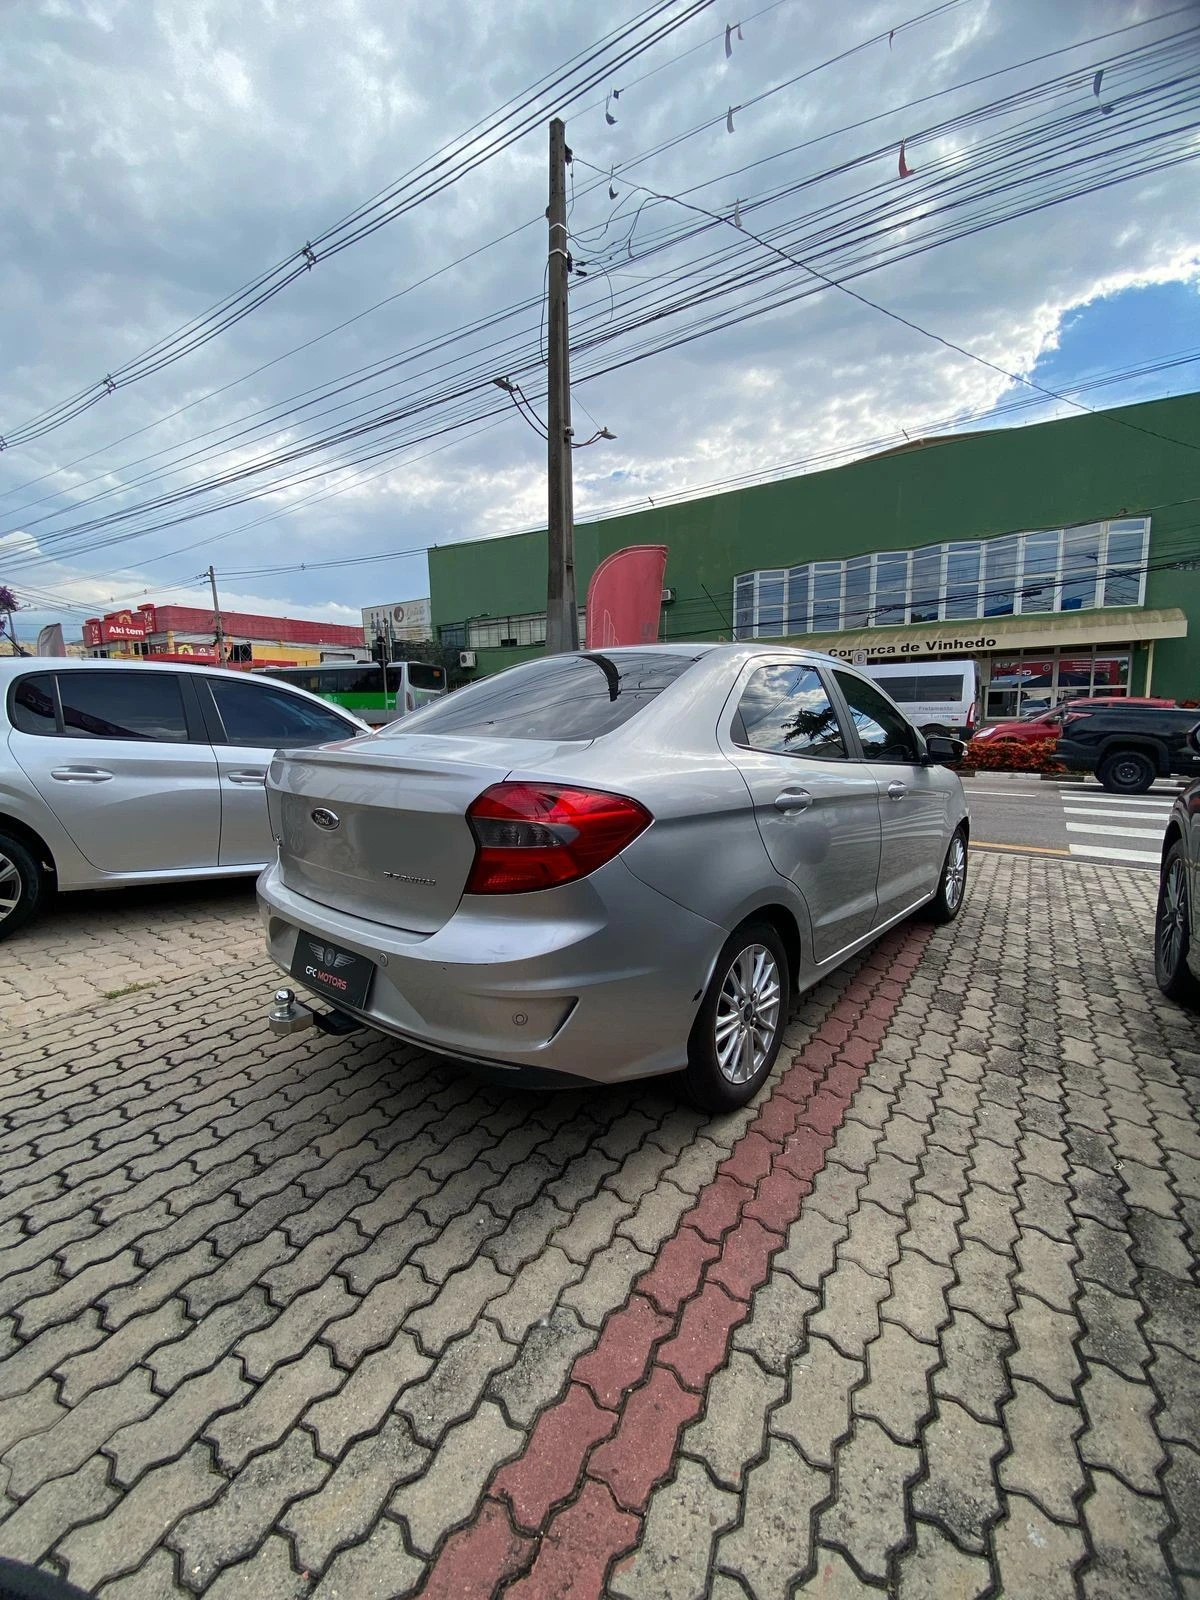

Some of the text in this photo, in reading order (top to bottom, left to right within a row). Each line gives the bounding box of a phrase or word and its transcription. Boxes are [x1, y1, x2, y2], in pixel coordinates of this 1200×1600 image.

[109, 626, 144, 636] Aki tem
[900, 643, 920, 652] de
[926, 637, 996, 651] Vinhedo
[317, 970, 347, 990] MOTORS
